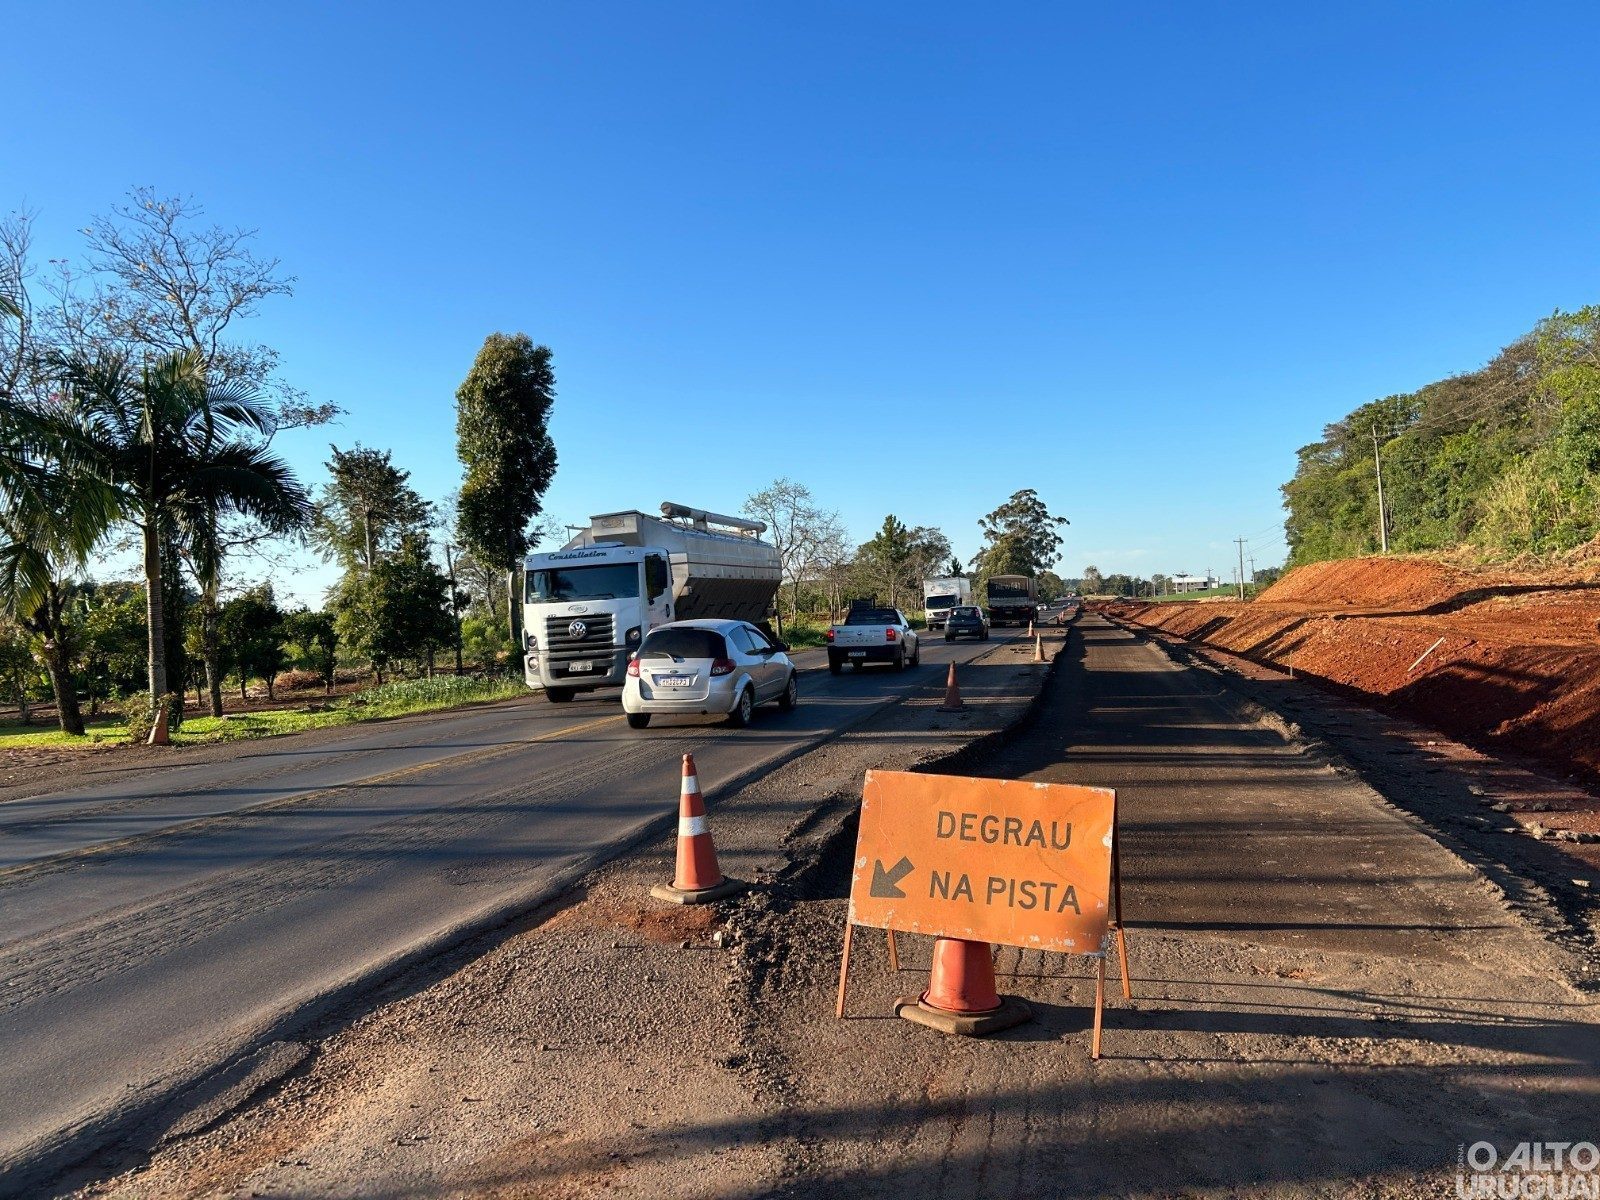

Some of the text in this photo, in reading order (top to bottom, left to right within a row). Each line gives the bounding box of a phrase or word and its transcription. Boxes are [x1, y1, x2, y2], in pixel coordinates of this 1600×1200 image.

[548, 550, 607, 560] Constellation
[936, 810, 1073, 851] DEGRAU
[929, 870, 1082, 916] NA PISTA
